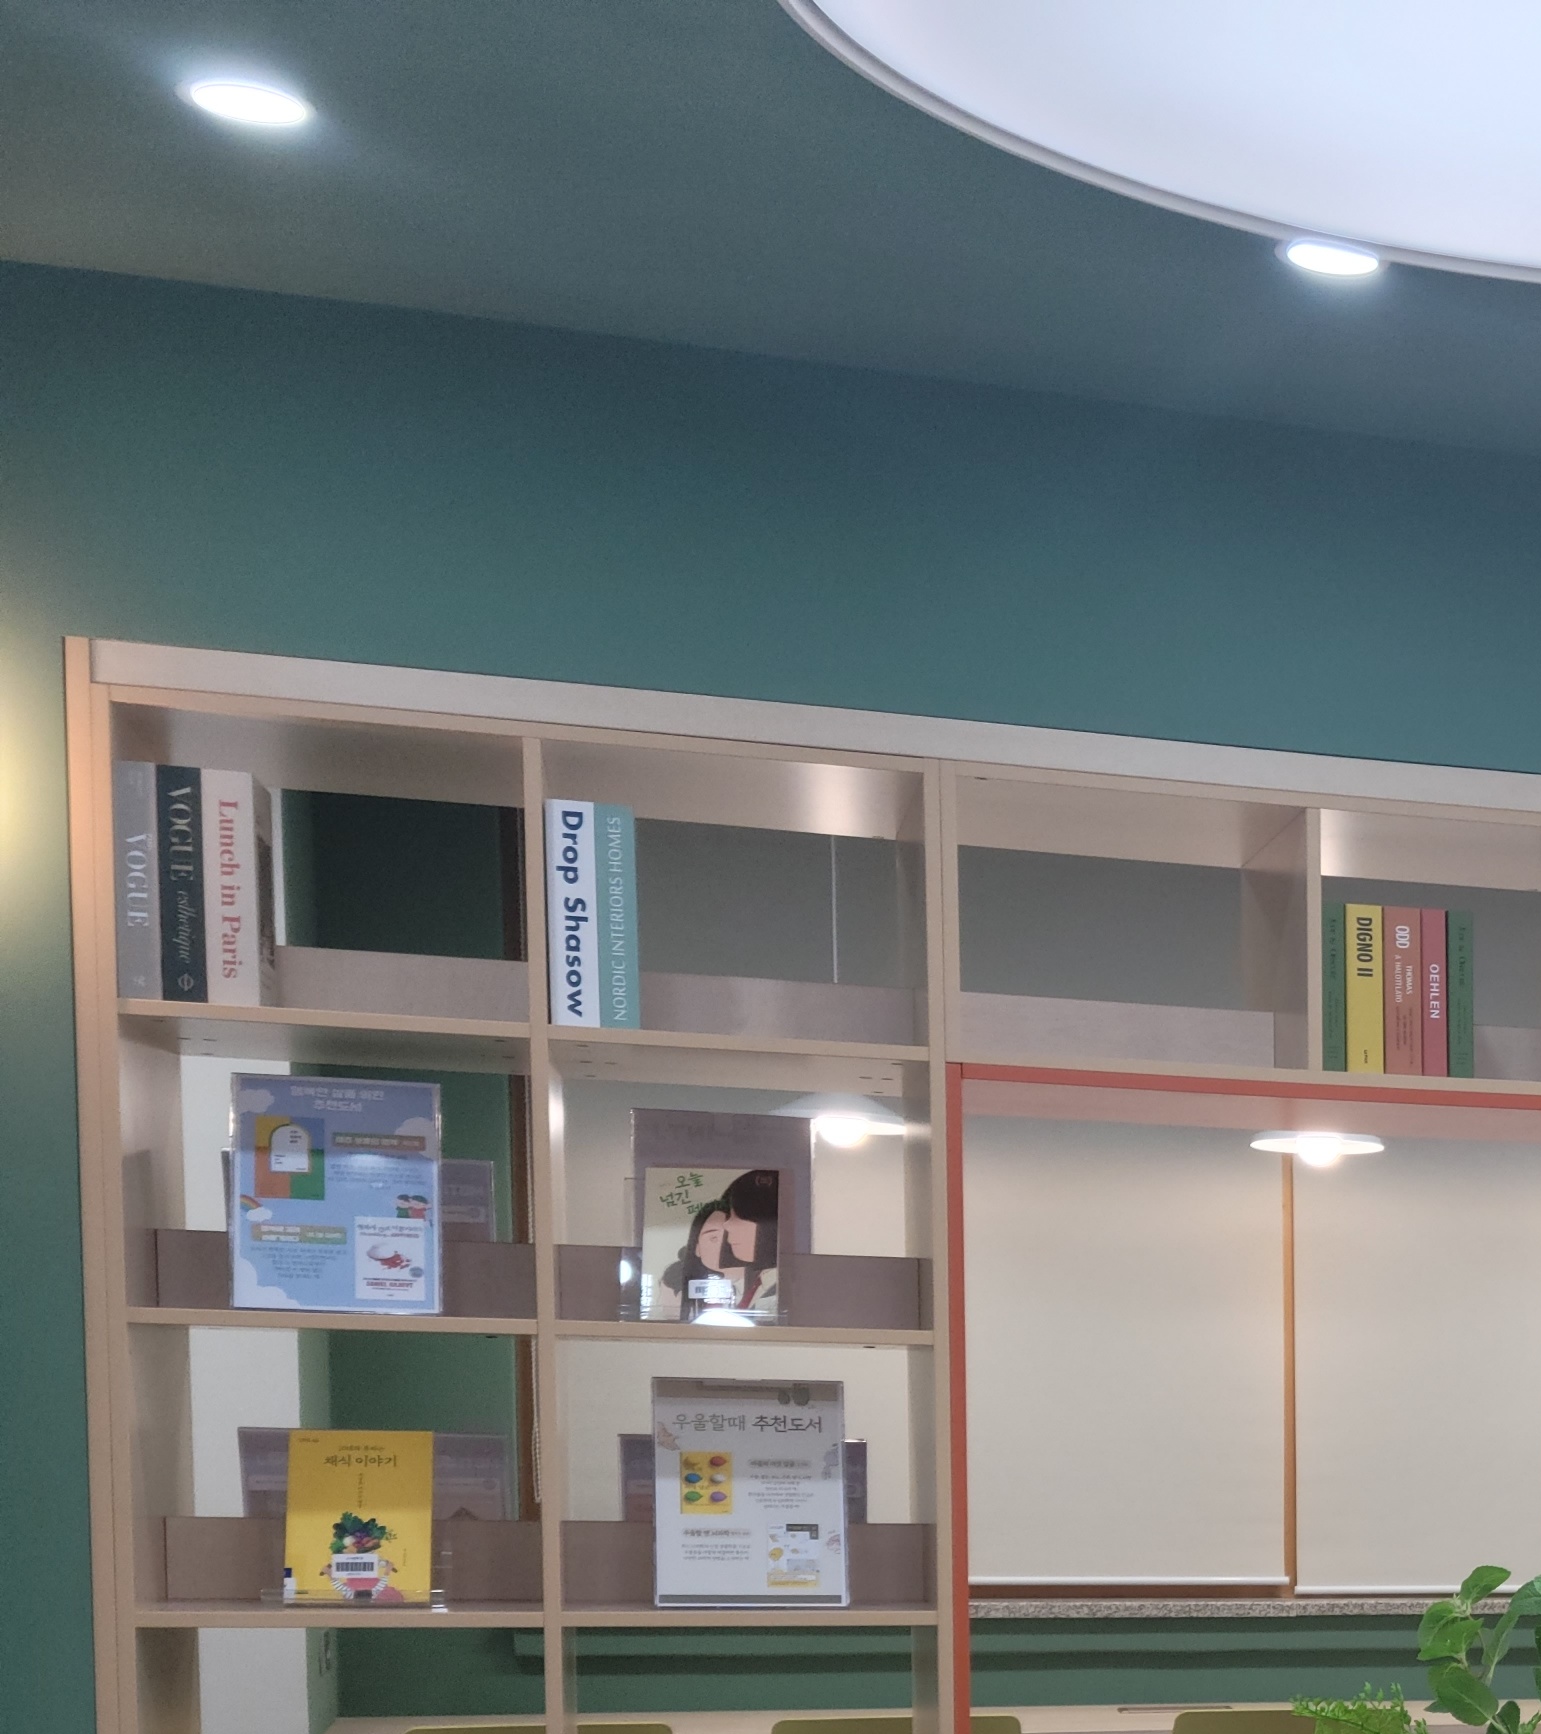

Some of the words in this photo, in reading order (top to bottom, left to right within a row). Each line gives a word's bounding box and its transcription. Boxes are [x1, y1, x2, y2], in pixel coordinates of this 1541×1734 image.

[167, 787, 194, 881] VOGUE
[218, 799, 240, 876] Lunch
[556, 810, 583, 885] Drop
[607, 817, 621, 874] HOMES
[125, 833, 149, 927] VOGUE
[221, 884, 240, 907] in
[609, 877, 625, 958] INTERIORS
[1356, 917, 1373, 963] DIGNO
[1395, 925, 1410, 949] ODD
[221, 915, 243, 979] Paris
[563, 897, 588, 1018] Shasow
[612, 960, 627, 1021] NORDIC
[1405, 965, 1413, 995] THOMAS
[1429, 964, 1440, 1019] OEHLEN
[659, 1190, 691, 1207] 넘긴
[675, 1171, 704, 1188] 오늘
[752, 1415, 823, 1433] 추천도서
[324, 1454, 351, 1467] 채식
[355, 1454, 397, 1467] 이야기
